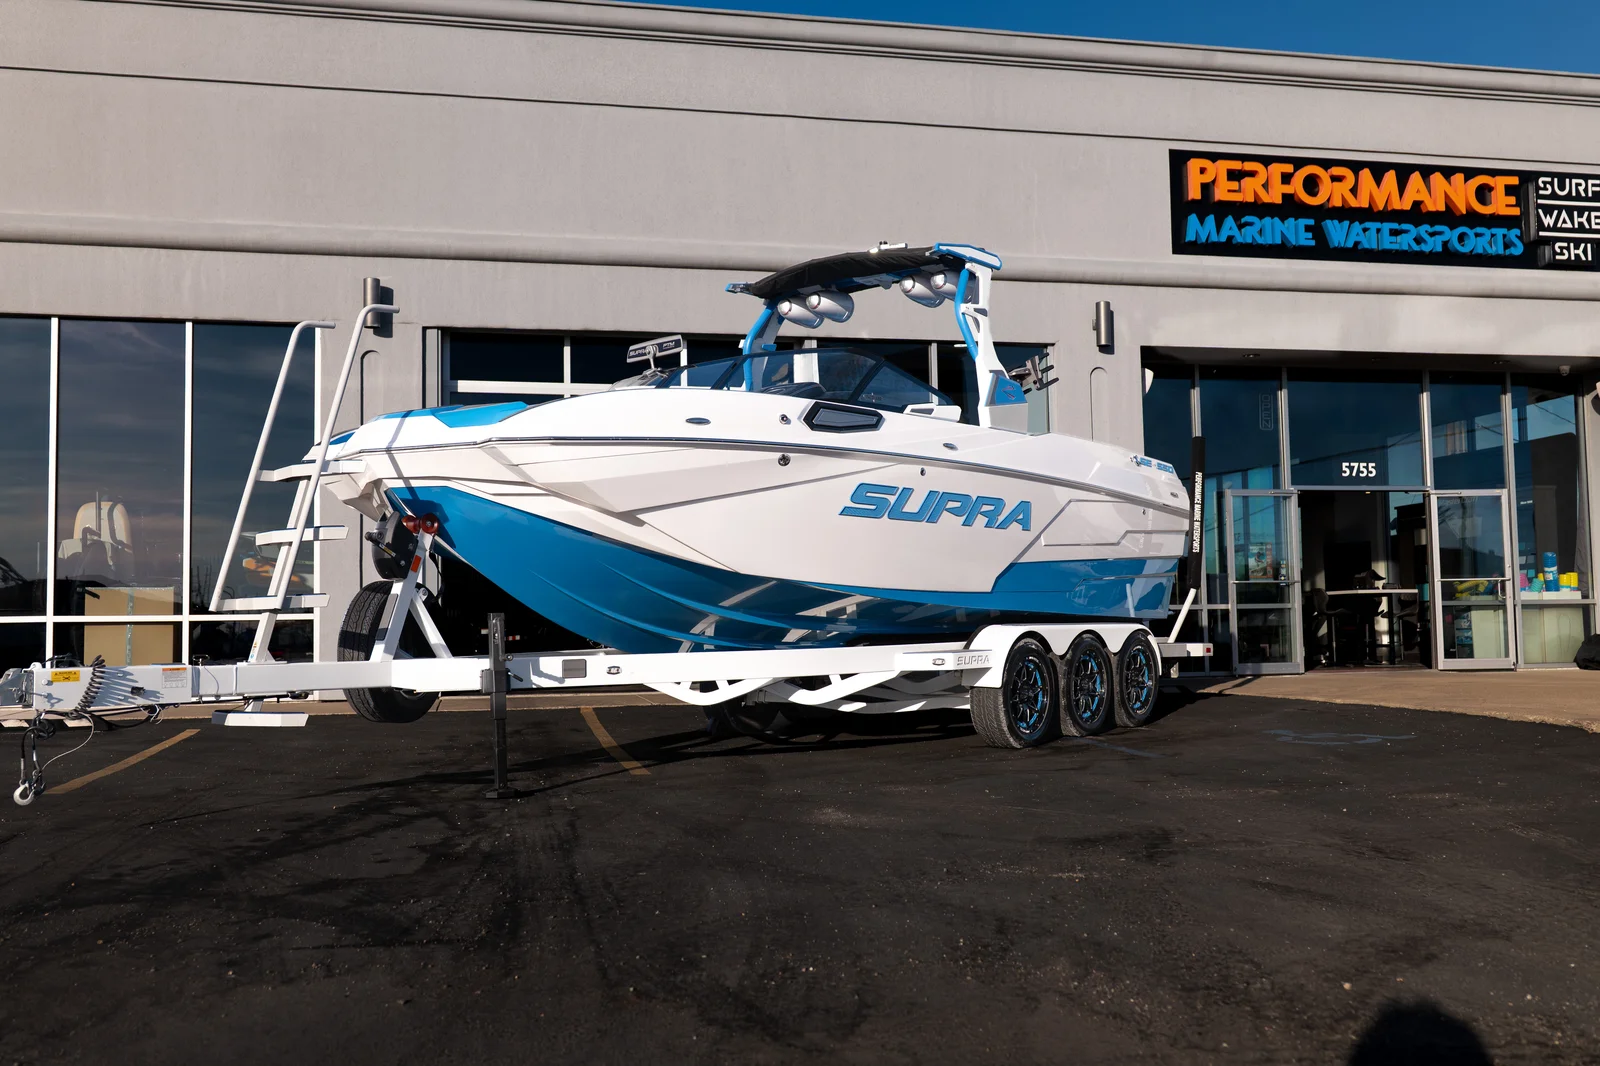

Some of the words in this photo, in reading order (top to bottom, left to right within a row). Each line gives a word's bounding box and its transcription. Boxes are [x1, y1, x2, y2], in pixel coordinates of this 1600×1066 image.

[1187, 158, 1520, 216] PERFORMANCE
[1538, 176, 1600, 197] SURF
[1537, 208, 1600, 229] WAKE
[1185, 213, 1316, 246] MARINE
[1322, 219, 1524, 257] WATERSPORTS
[1554, 242, 1592, 261] SKI
[1261, 394, 1271, 429] OPEN
[1341, 462, 1376, 477] 5755
[839, 482, 1032, 532] SUPRA
[1192, 522, 1200, 552] WATERSPORTS
[957, 654, 990, 666] SUPRA
